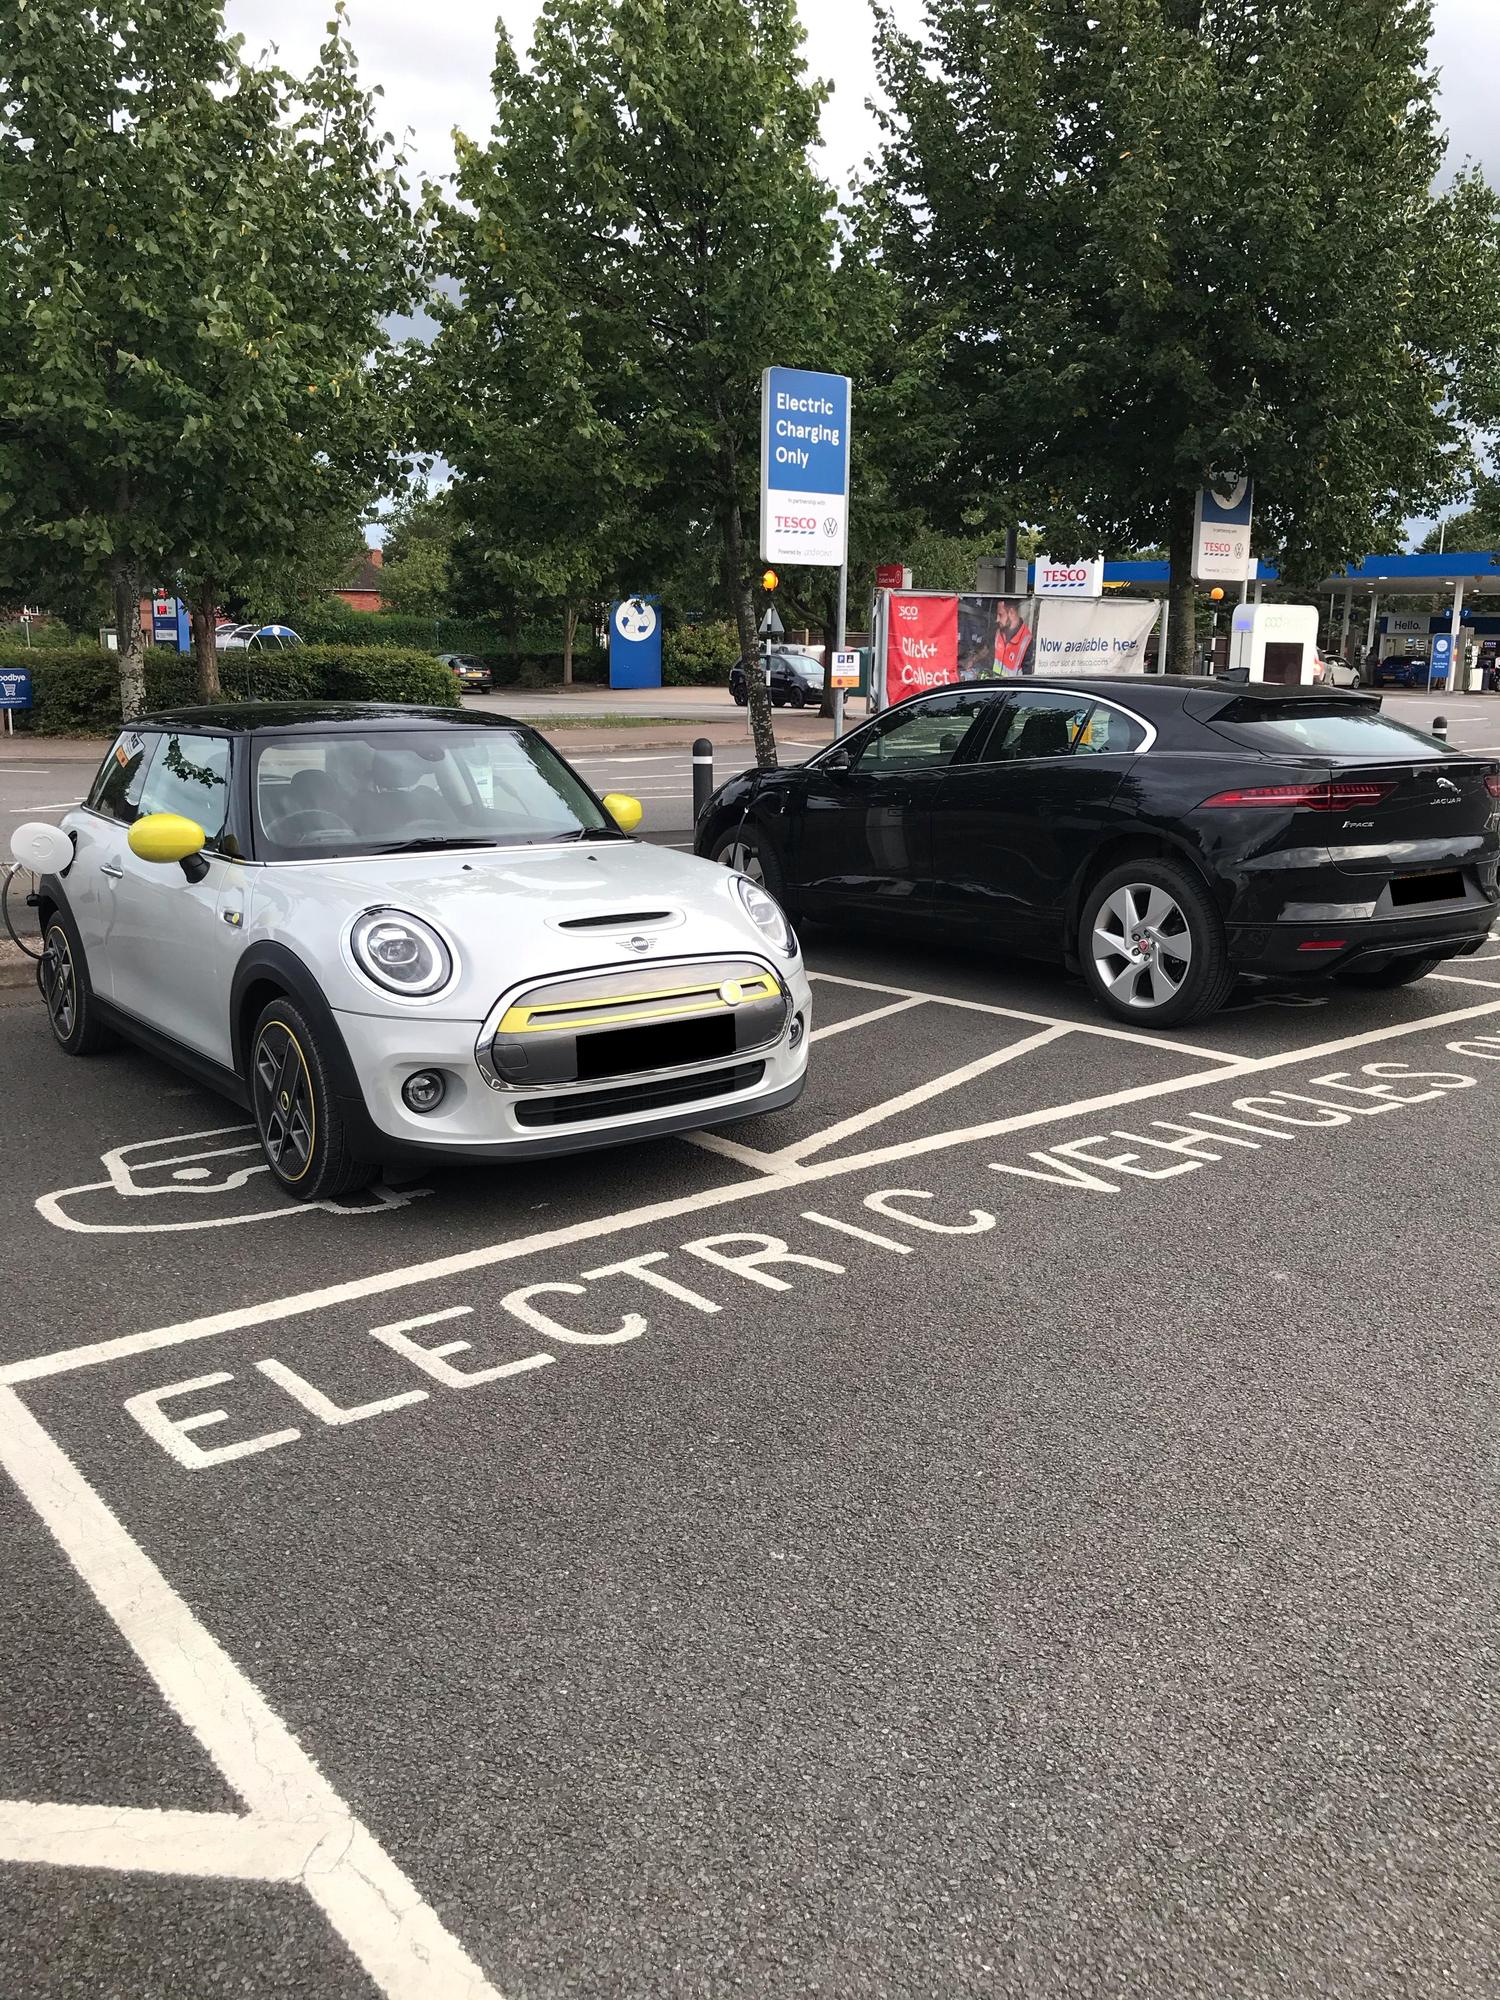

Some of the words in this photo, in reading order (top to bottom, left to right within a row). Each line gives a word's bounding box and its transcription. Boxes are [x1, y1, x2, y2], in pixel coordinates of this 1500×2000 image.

[776, 392, 834, 415] Electric
[776, 419, 840, 446] Charging
[775, 446, 809, 469] Only
[774, 515, 817, 530] TESCO
[1204, 541, 1231, 553] TESCO
[1043, 569, 1087, 582] TESCO
[1394, 620, 1421, 630] Hello.
[1040, 637, 1062, 652] Now
[1065, 637, 1109, 653] available
[901, 664, 951, 686] Collect
[1430, 796, 1462, 805] JAGUAR
[123, 1188, 996, 1470] ELECTRIC
[987, 1062, 1478, 1194] VEHICLES
